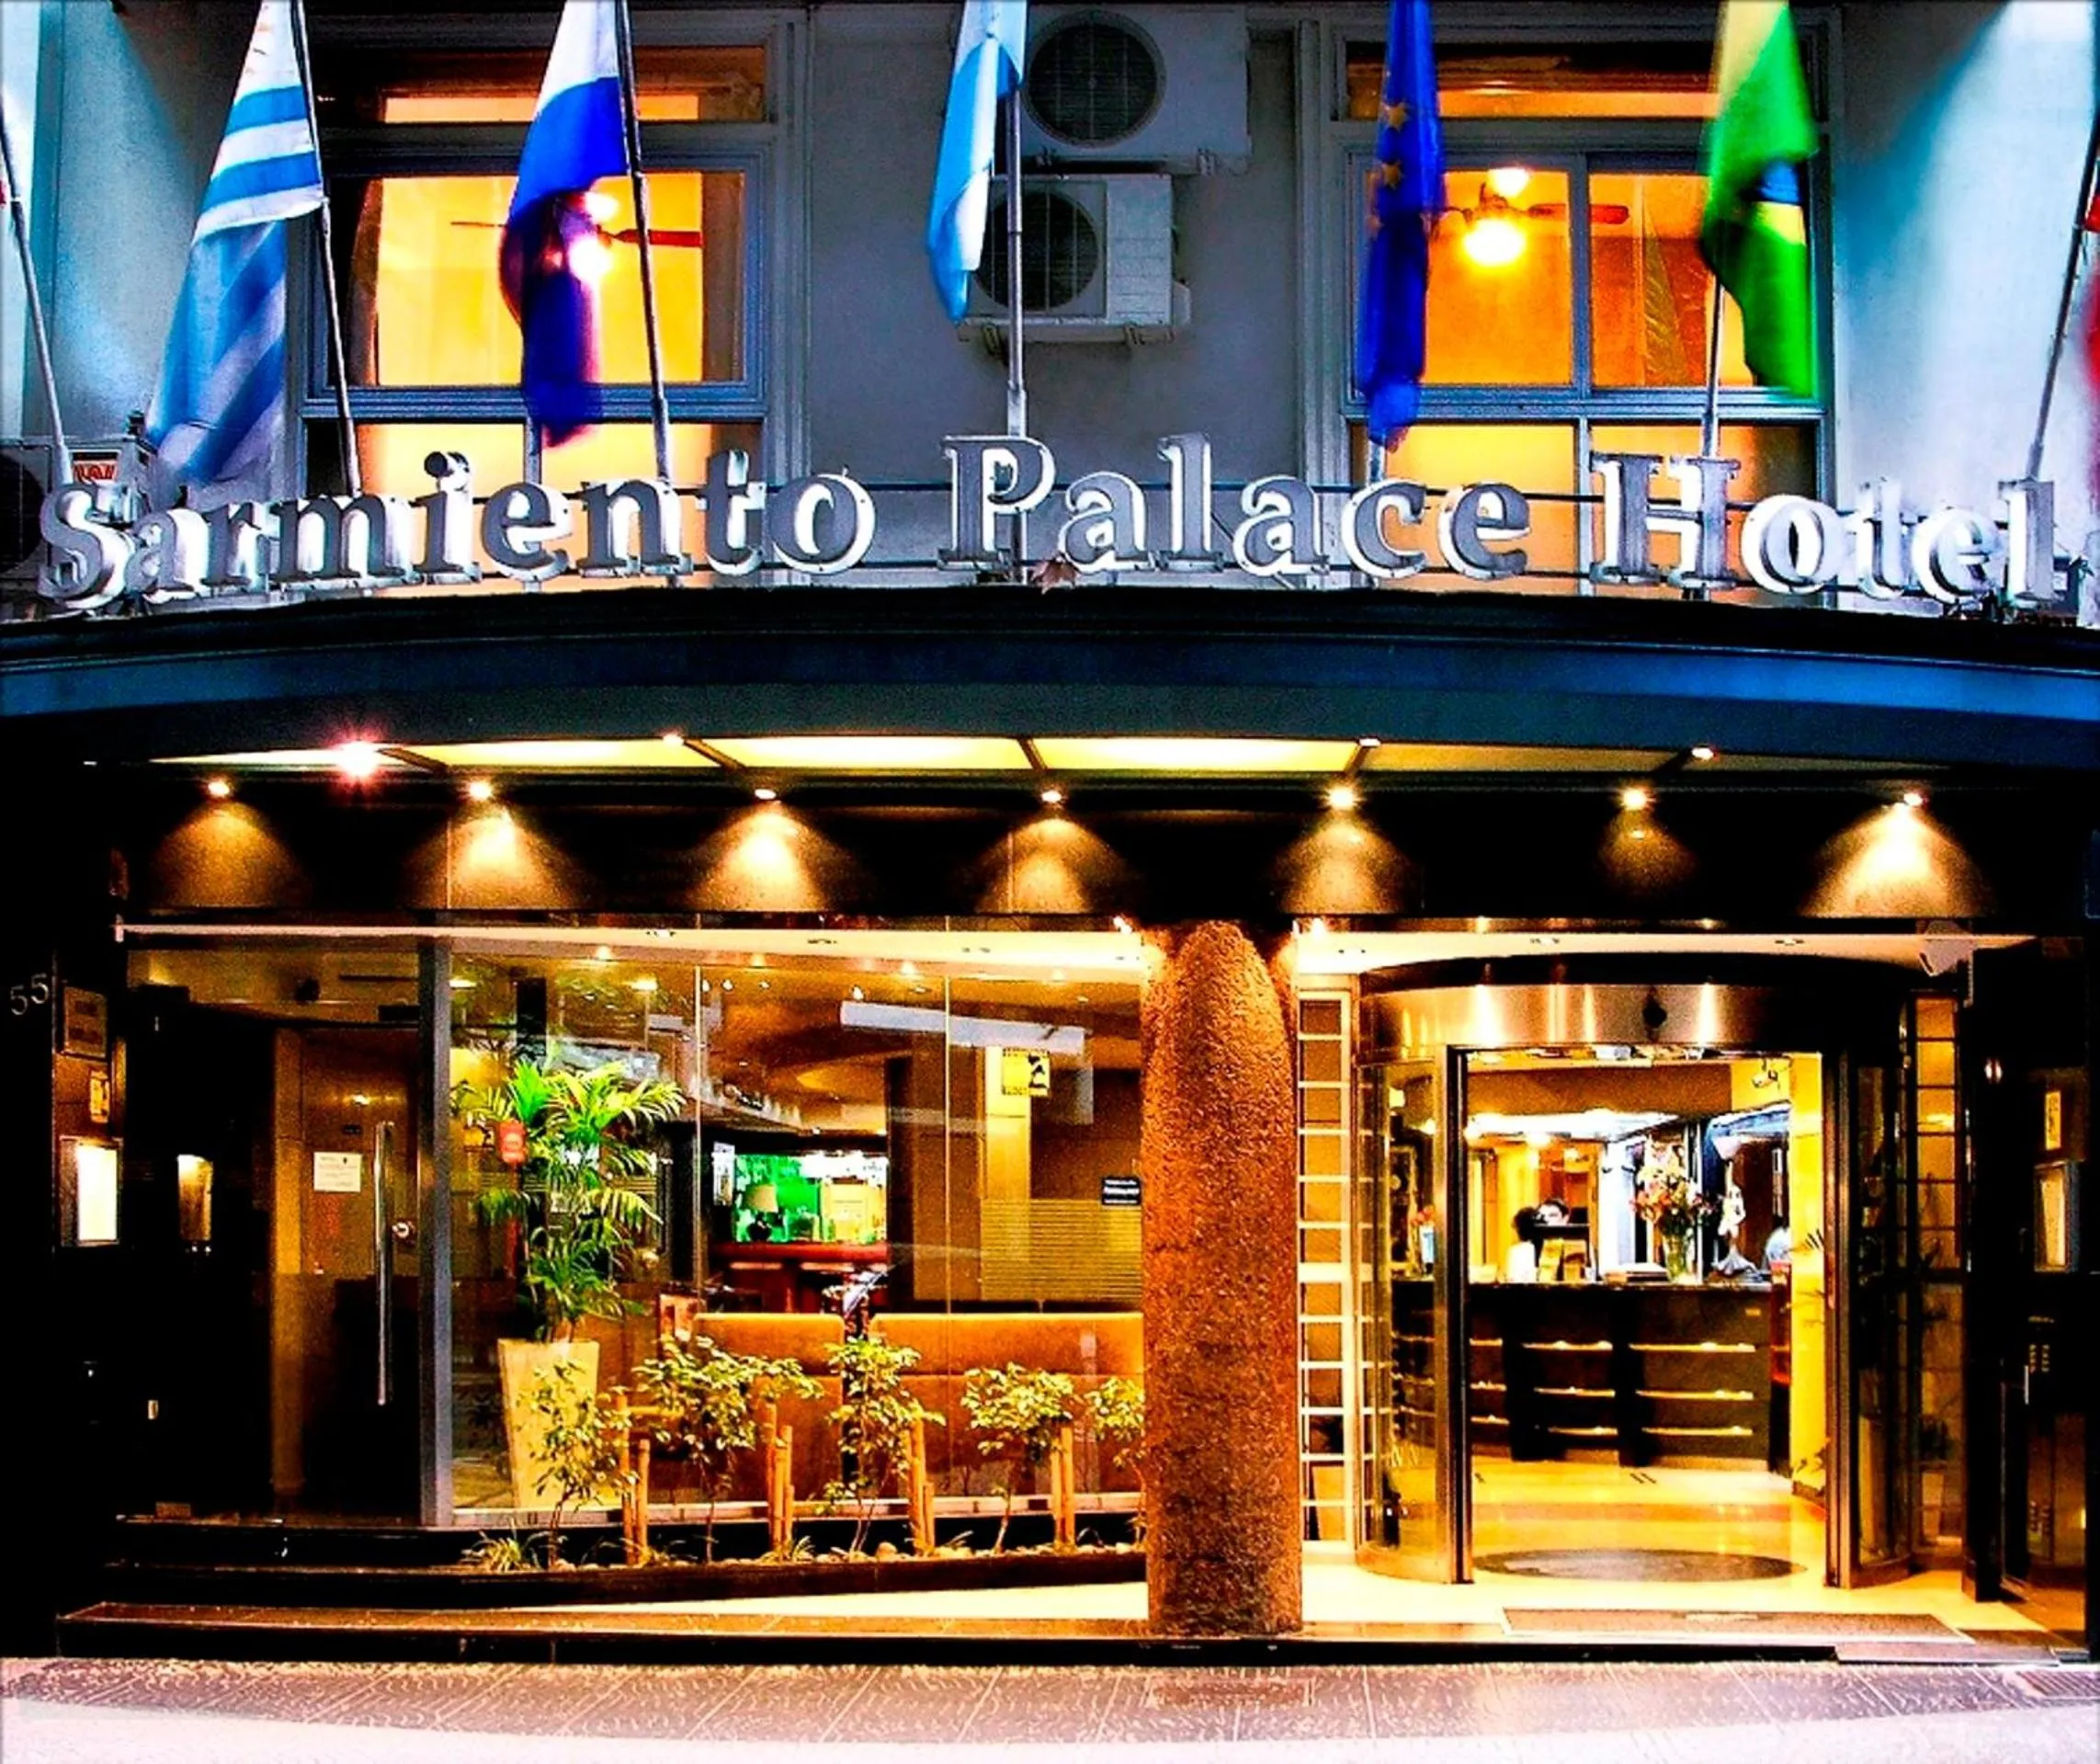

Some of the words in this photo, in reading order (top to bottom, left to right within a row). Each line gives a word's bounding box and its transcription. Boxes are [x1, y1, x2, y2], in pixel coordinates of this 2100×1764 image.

[39, 449, 877, 610] Sarmiento
[937, 433, 1531, 580] Palace
[1588, 452, 2059, 607] Hotel
[10, 973, 49, 1016] 55
